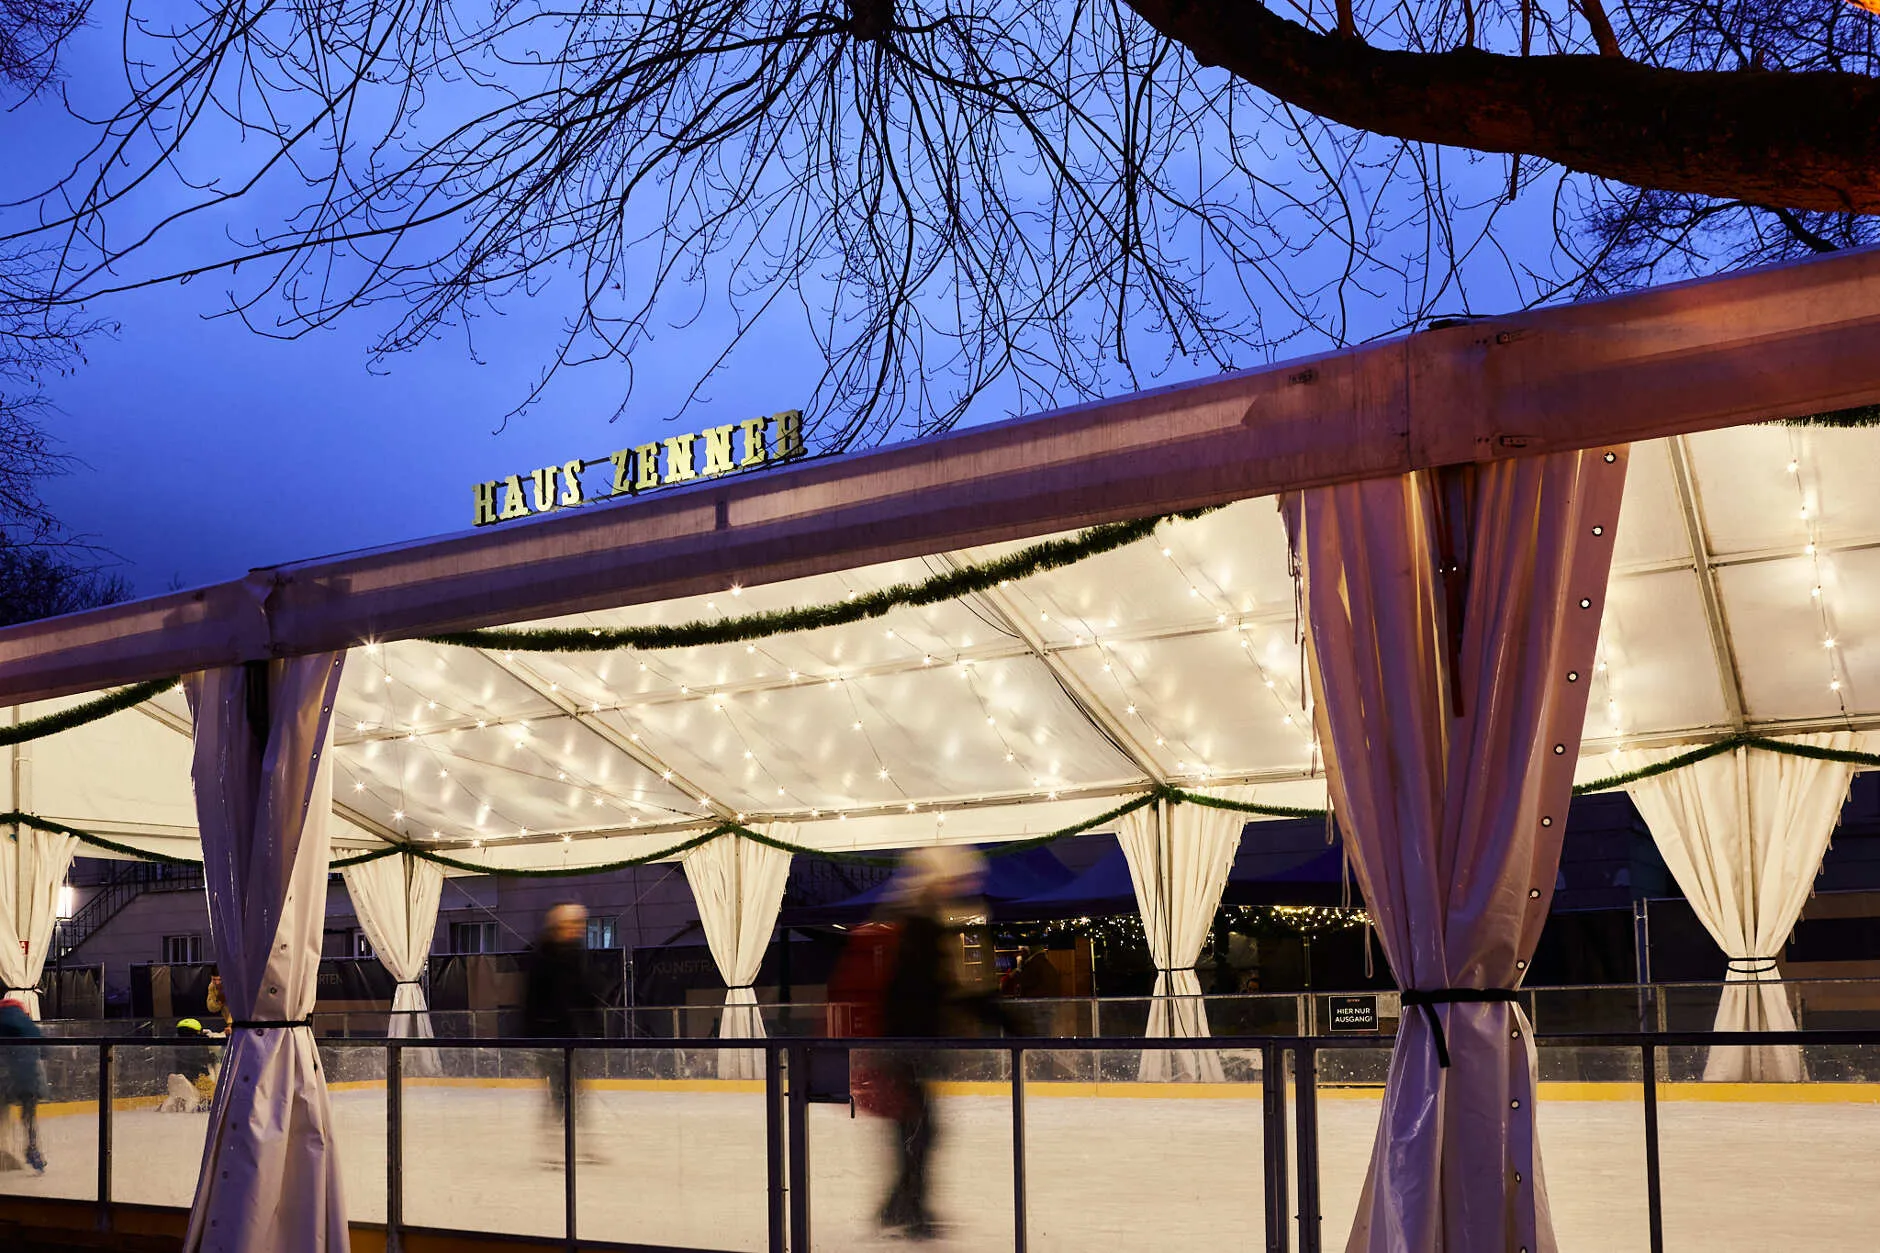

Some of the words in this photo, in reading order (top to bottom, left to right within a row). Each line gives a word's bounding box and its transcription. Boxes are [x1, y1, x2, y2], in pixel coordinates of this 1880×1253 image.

[472, 459, 585, 527] HAUS
[610, 409, 808, 496] ZENNER
[1335, 1015, 1373, 1023] AUSGANG!
